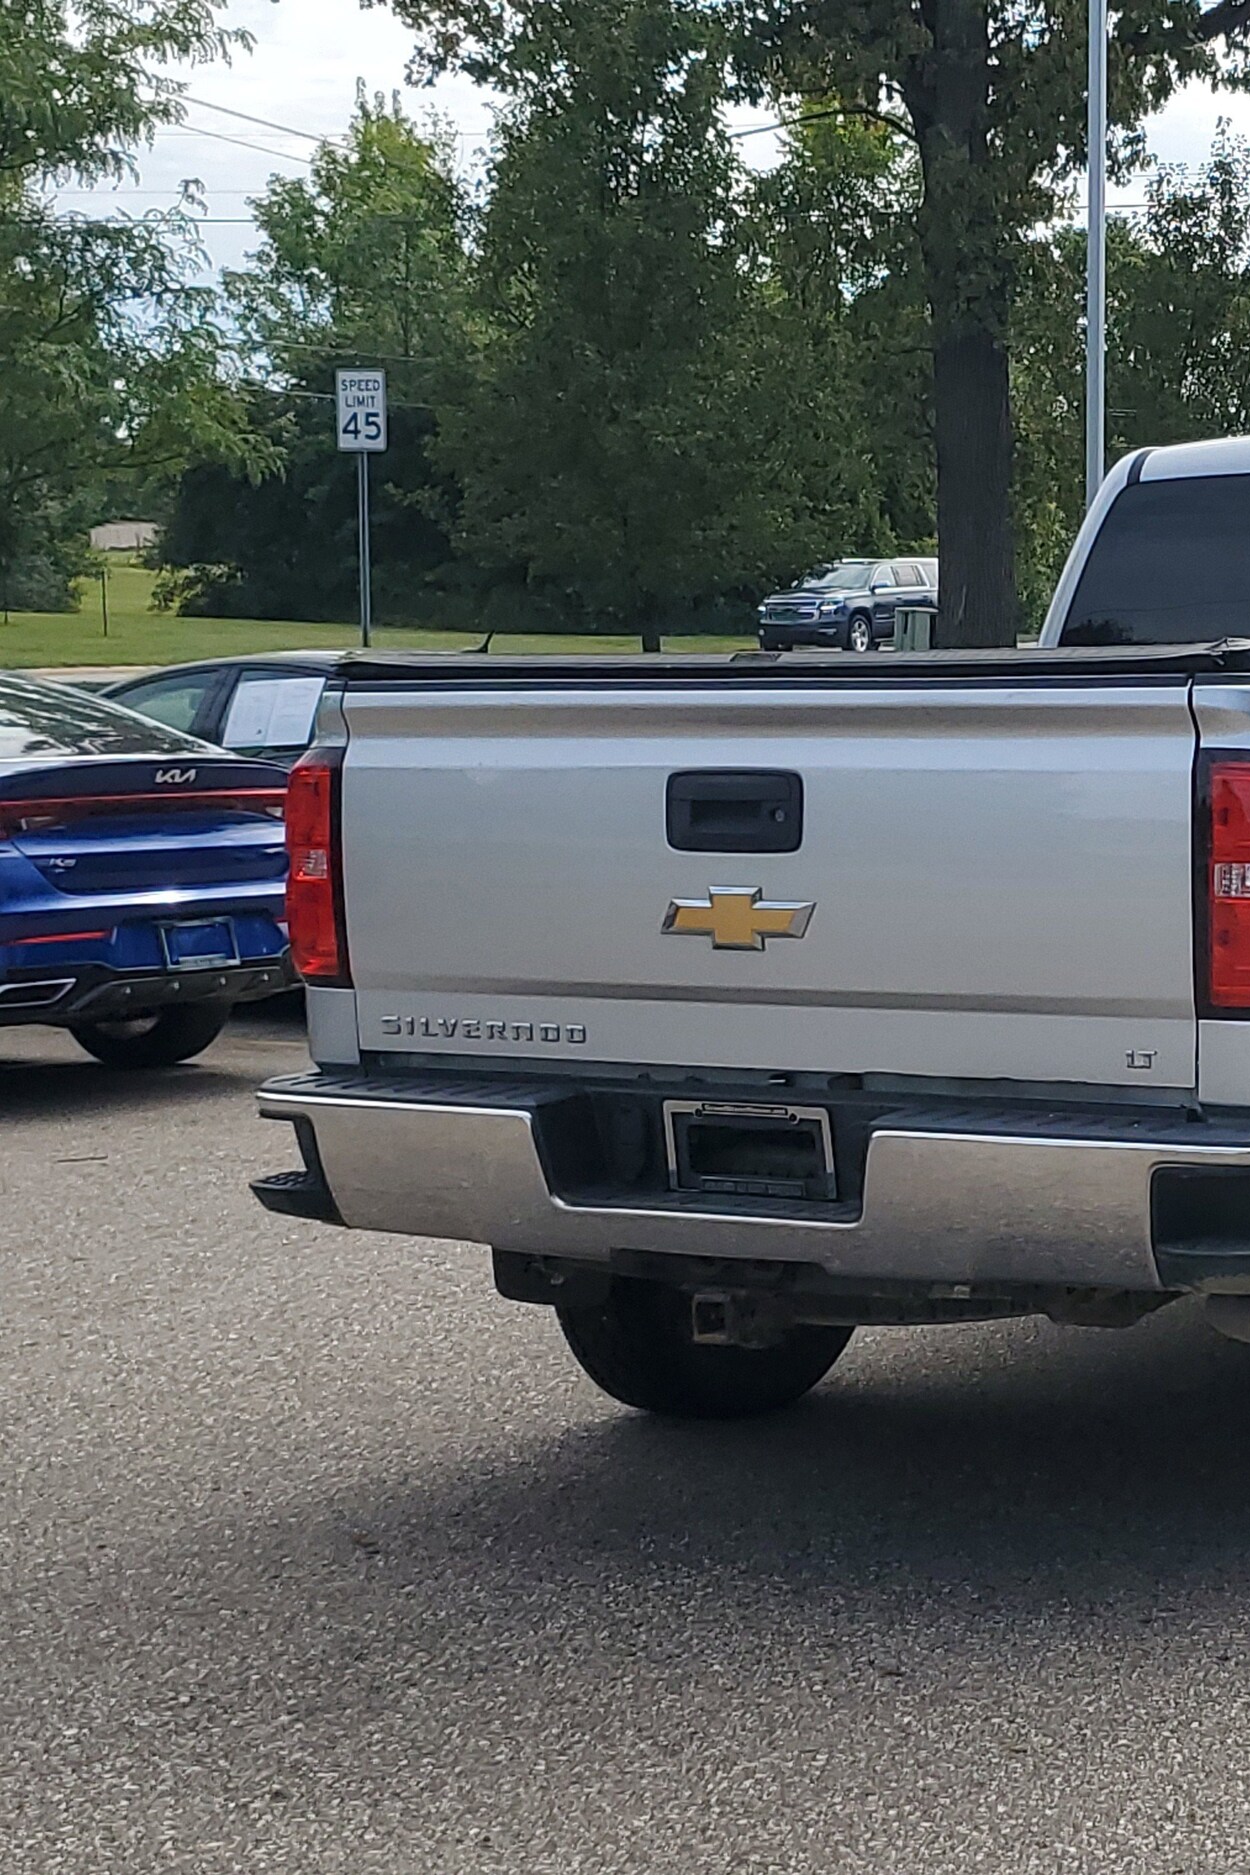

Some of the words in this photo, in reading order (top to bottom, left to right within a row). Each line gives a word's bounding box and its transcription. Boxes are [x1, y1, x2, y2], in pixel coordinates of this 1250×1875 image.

[341, 379, 381, 392] SPEED
[345, 395, 376, 408] LIMIT
[341, 411, 382, 441] 45
[154, 769, 197, 784] KIA
[381, 1015, 586, 1044] SILVERADO
[1126, 1050, 1158, 1069] LT
